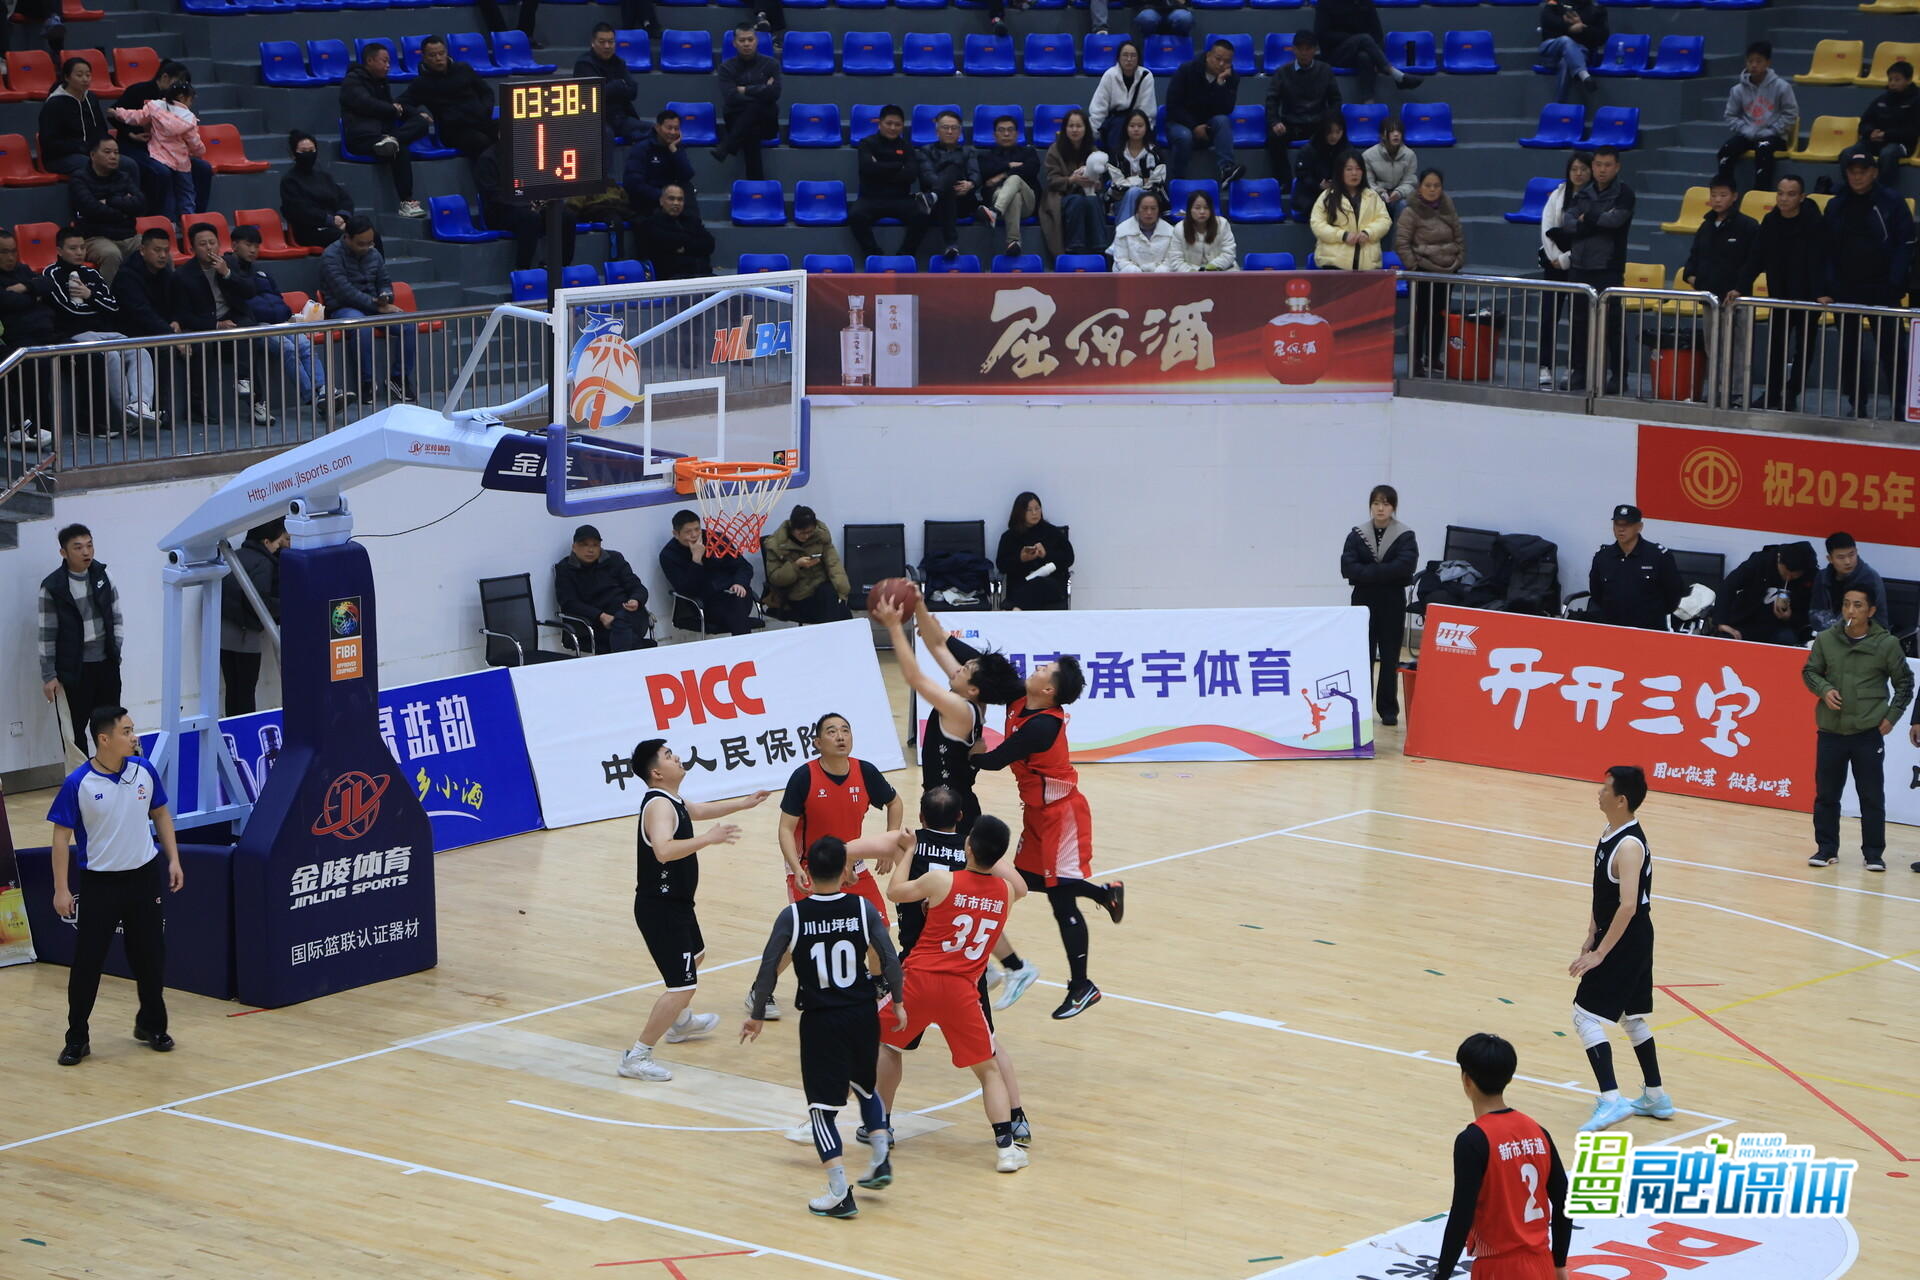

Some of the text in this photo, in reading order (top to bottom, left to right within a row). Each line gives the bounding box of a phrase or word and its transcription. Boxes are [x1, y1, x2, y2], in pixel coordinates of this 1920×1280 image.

[513, 84, 597, 119] 03:38.1
[710, 314, 793, 365] MLBA
[1763, 459, 1916, 520] 祝2025年
[335, 643, 358, 660] FIBA
[644, 660, 766, 731] PICC
[1479, 646, 1761, 758] 开开三宝
[1653, 761, 1718, 787] 用心做菜
[290, 846, 412, 896] 金陵体育
[290, 874, 409, 911] JINLING SPORTS
[803, 916, 860, 936] 川山坪镇
[953, 892, 1005, 914] 新市街道
[291, 917, 421, 967] 国际篮联认证器材
[941, 913, 999, 961] 35
[682, 951, 692, 972] 7
[810, 939, 857, 990] 10
[1498, 1137, 1547, 1161] 新市街道
[1520, 1162, 1545, 1224] 2
